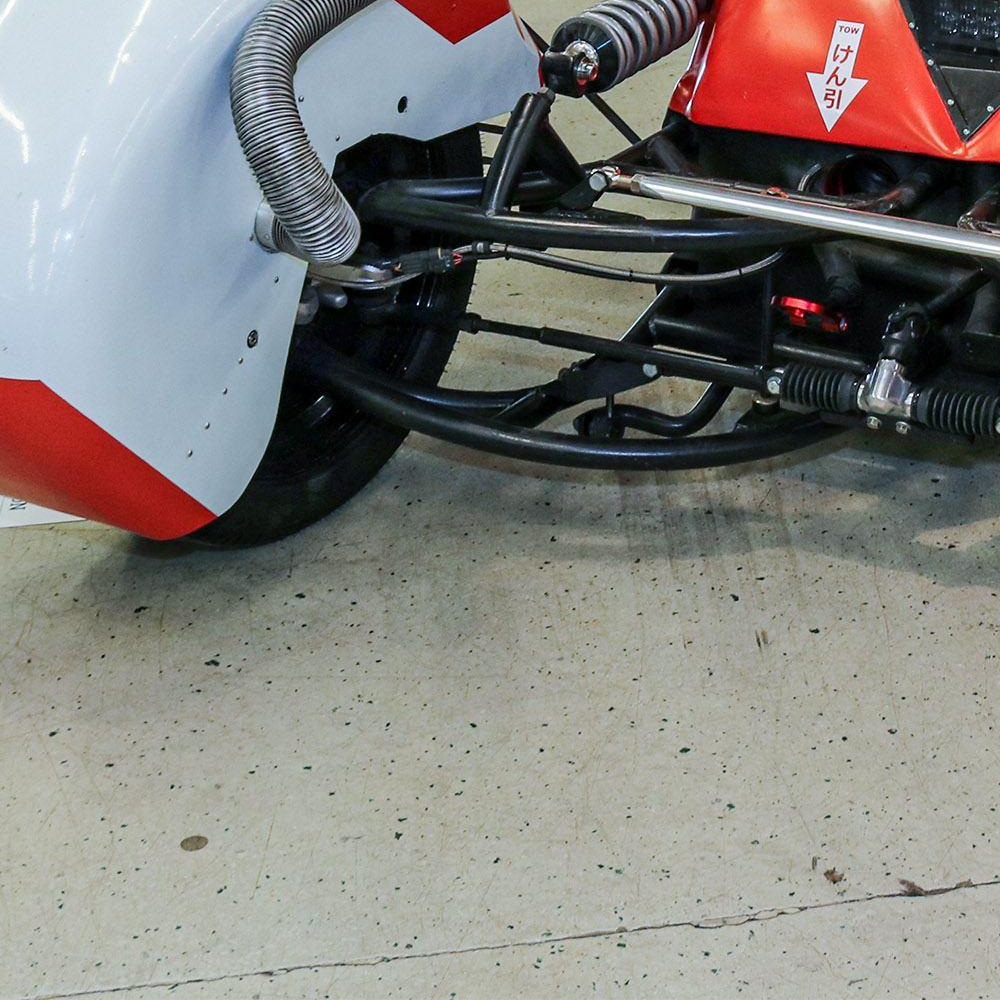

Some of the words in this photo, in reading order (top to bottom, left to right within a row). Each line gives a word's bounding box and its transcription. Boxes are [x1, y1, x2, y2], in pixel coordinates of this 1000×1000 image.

[839, 25, 860, 35] TOW
[823, 43, 854, 110] けん引
